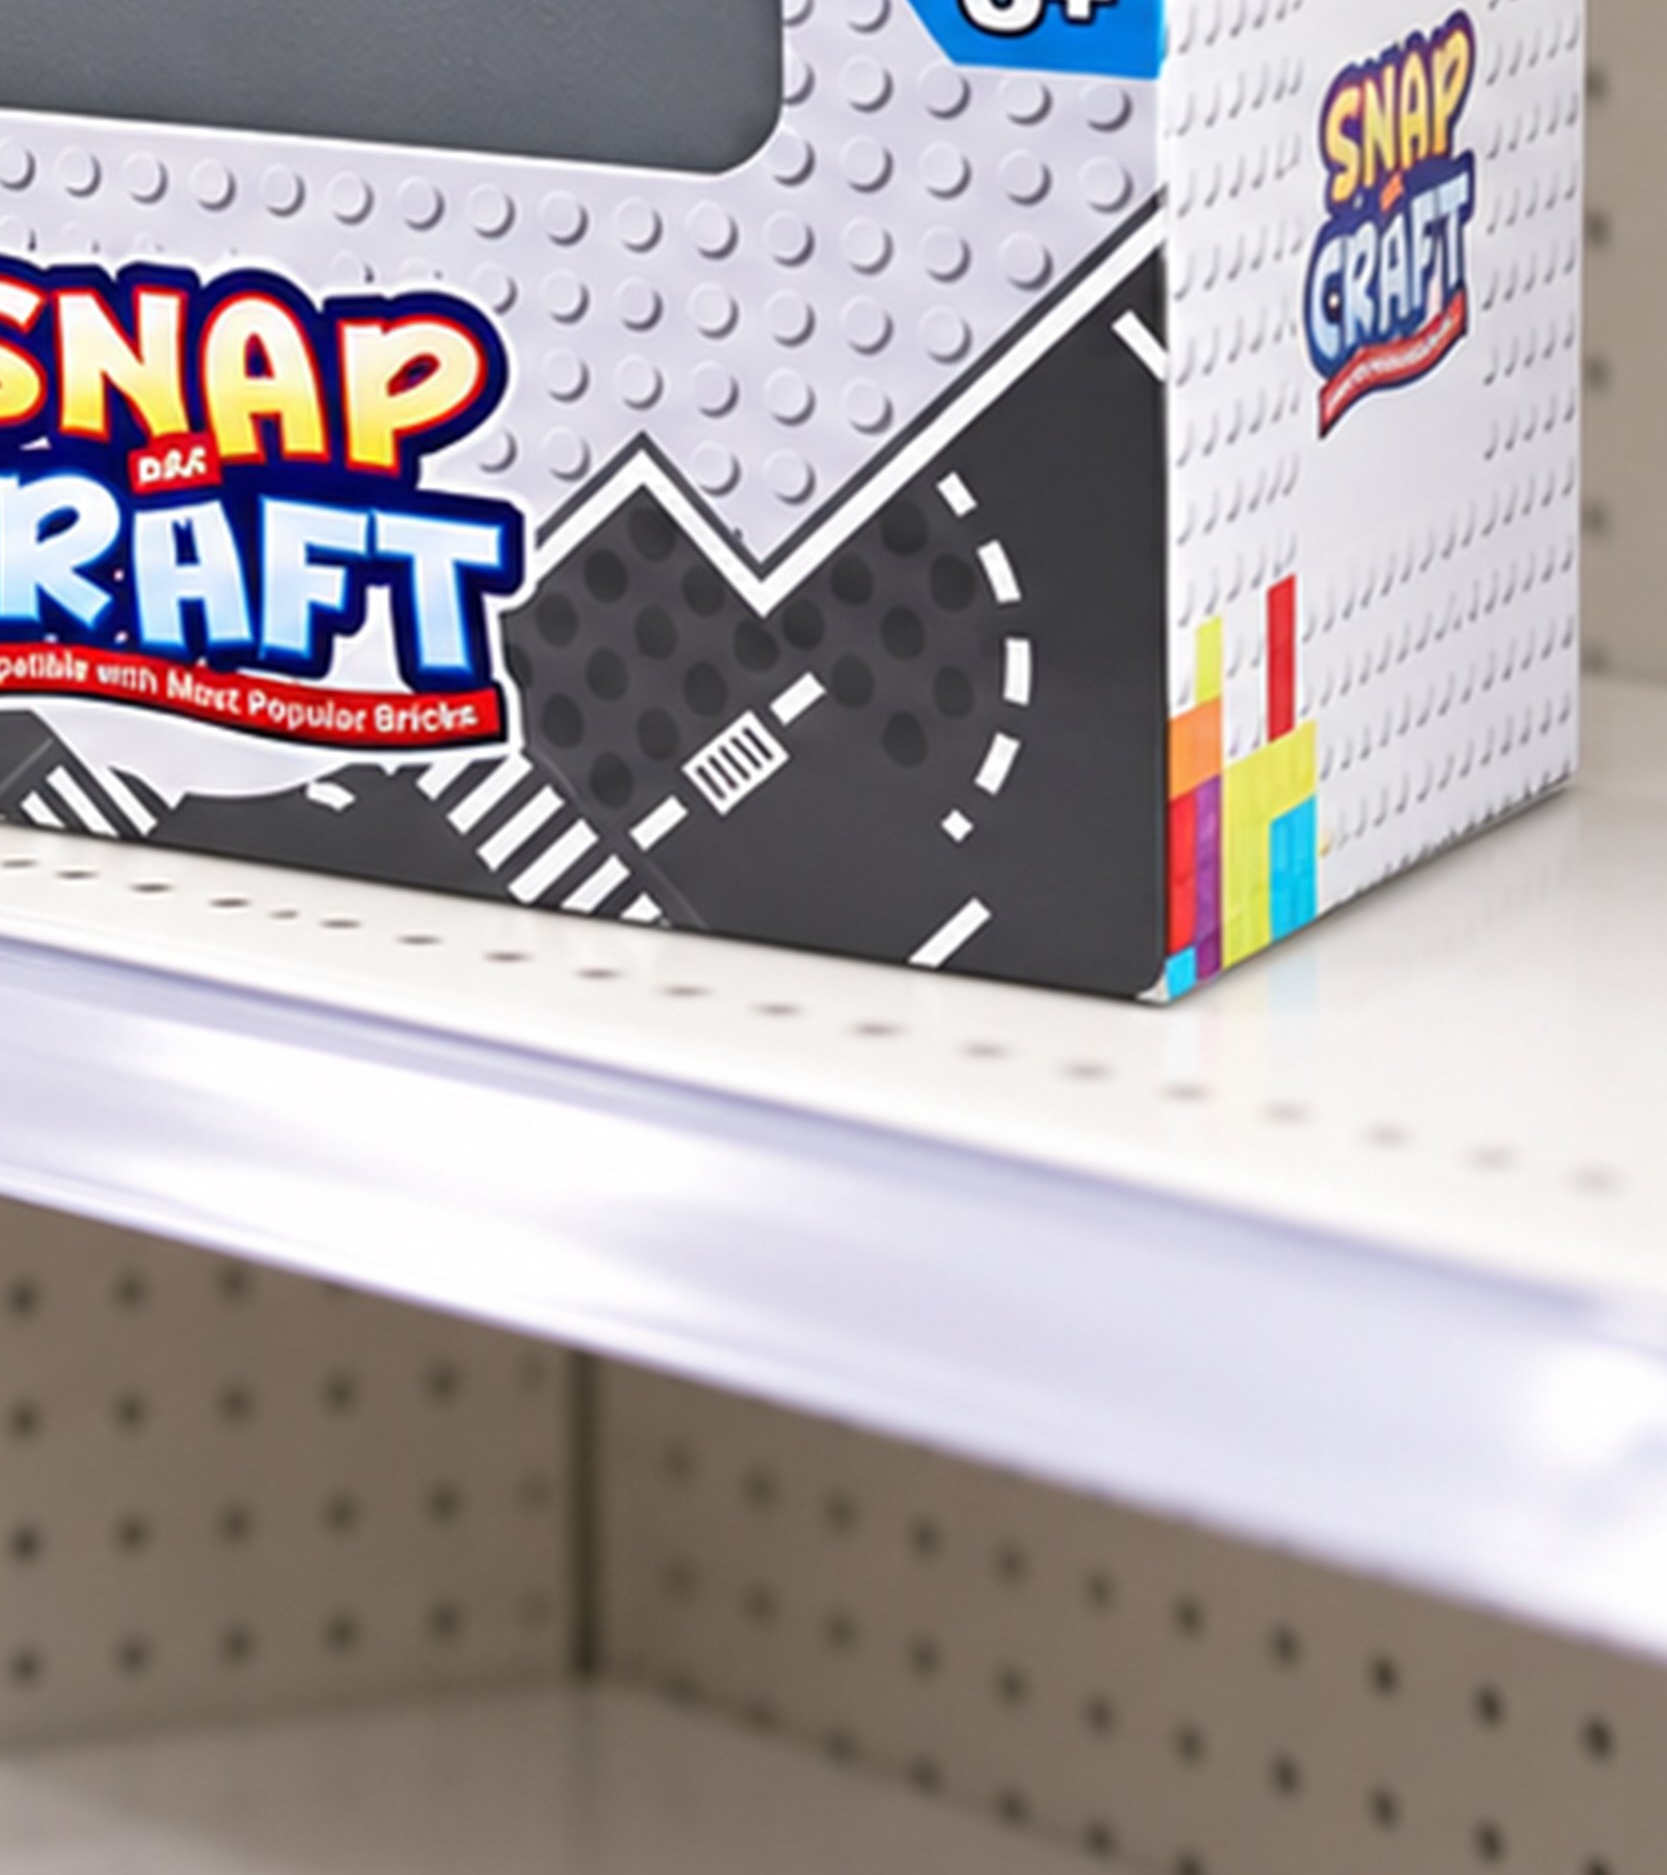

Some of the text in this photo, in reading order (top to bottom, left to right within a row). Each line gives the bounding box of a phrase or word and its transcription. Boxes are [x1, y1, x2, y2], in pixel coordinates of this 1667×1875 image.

[1325, 29, 1471, 203] SNAP
[1311, 172, 1468, 360] CRAFT
[247, 692, 367, 733] Popular
[374, 702, 480, 733] Bricks
